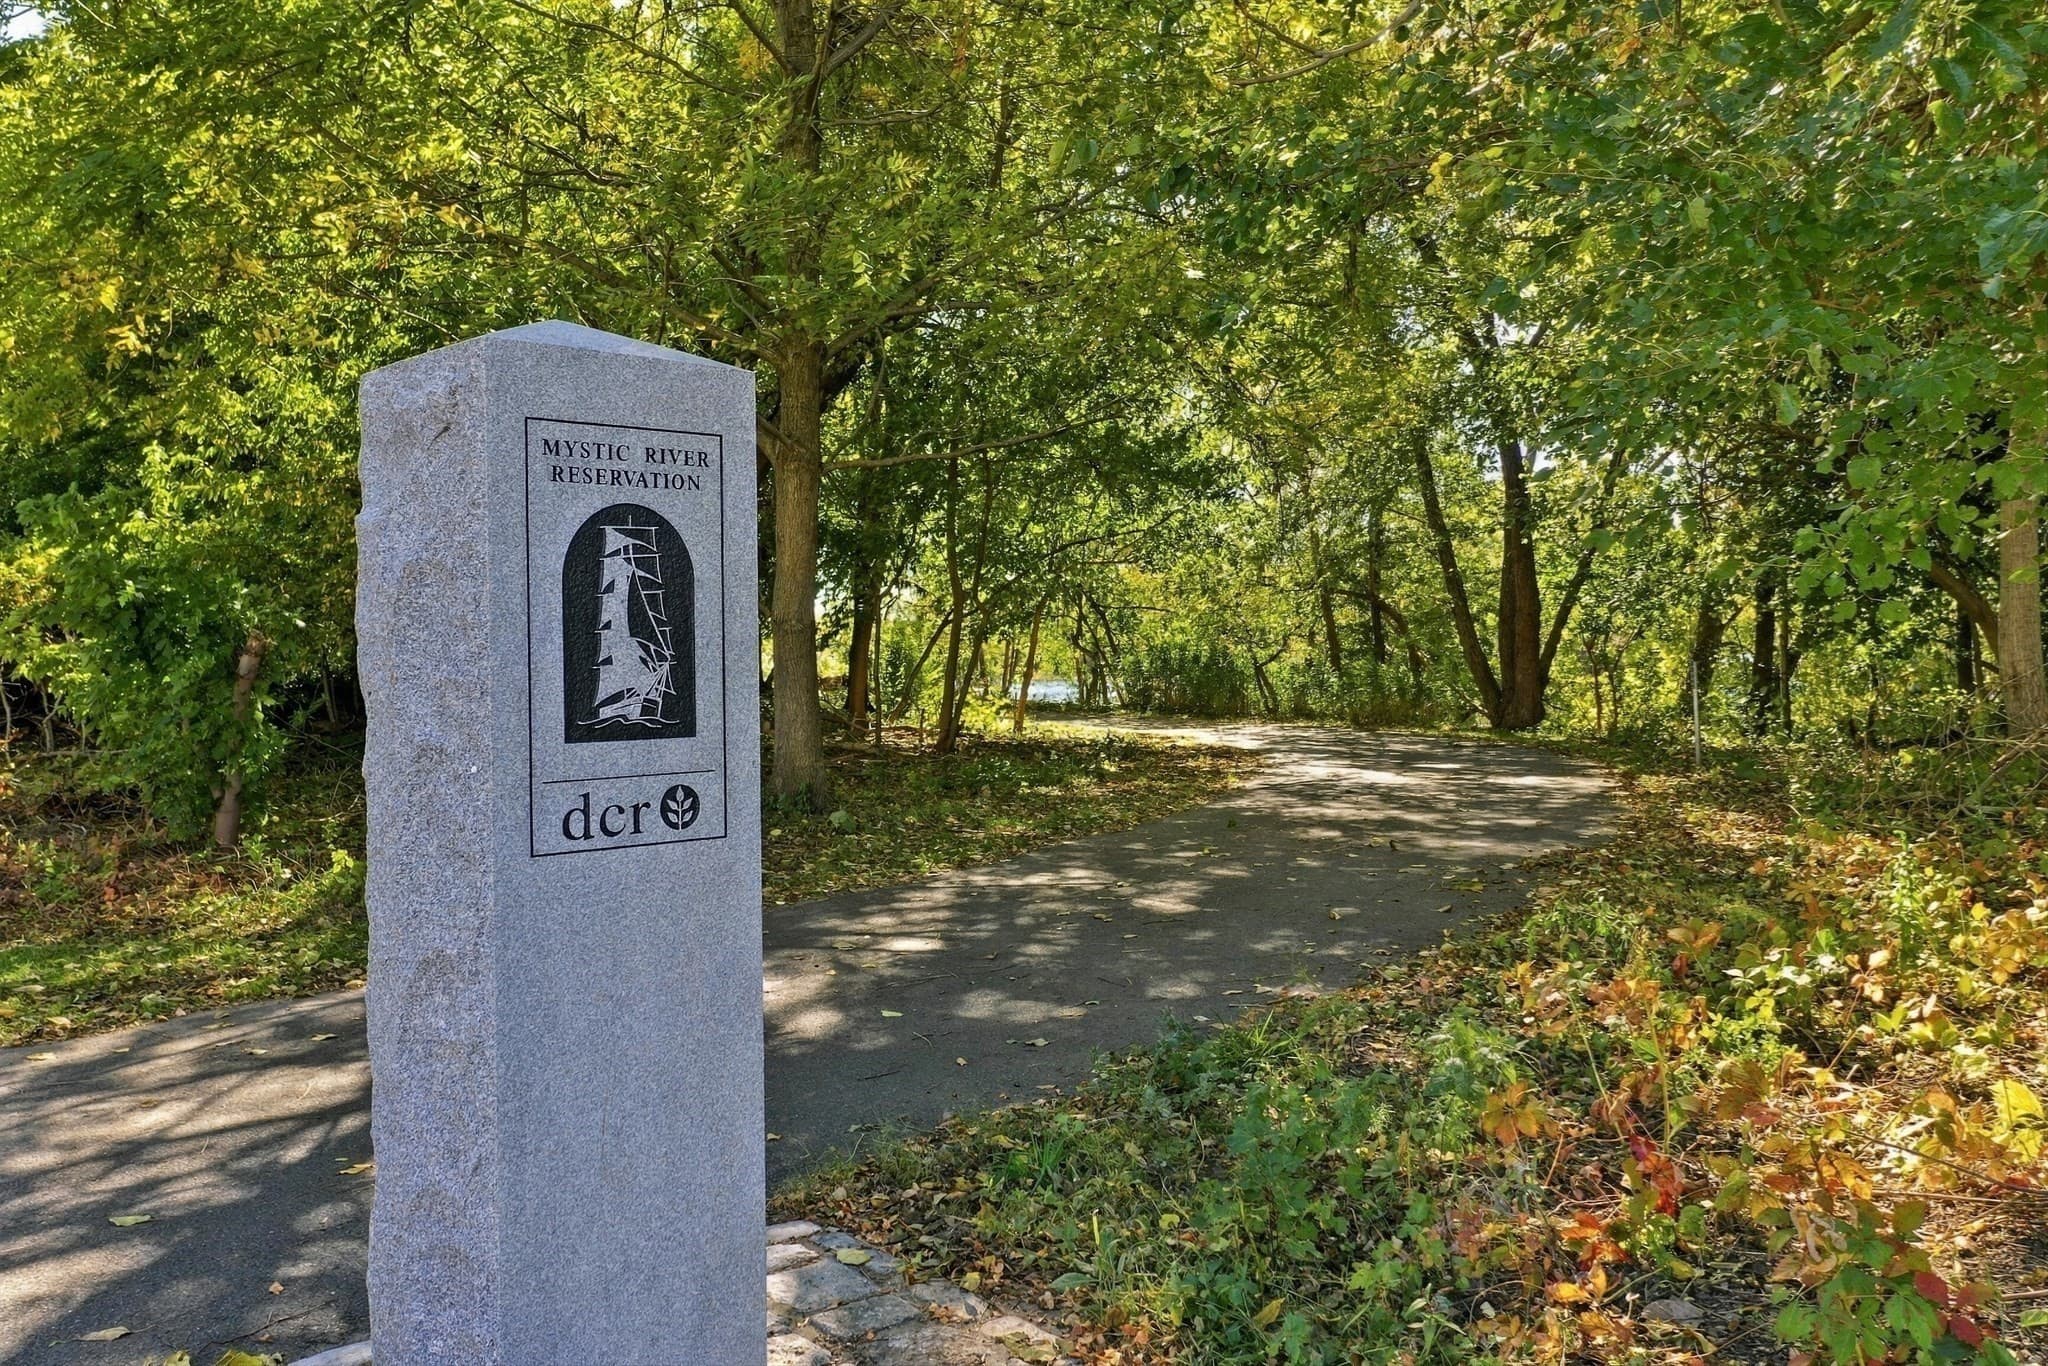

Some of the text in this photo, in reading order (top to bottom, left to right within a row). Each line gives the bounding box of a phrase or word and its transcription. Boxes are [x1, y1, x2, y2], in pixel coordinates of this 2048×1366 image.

[542, 438, 709, 468] MYSTIC RIVER
[551, 465, 700, 490] RESERVATION
[562, 792, 651, 841] dcr
